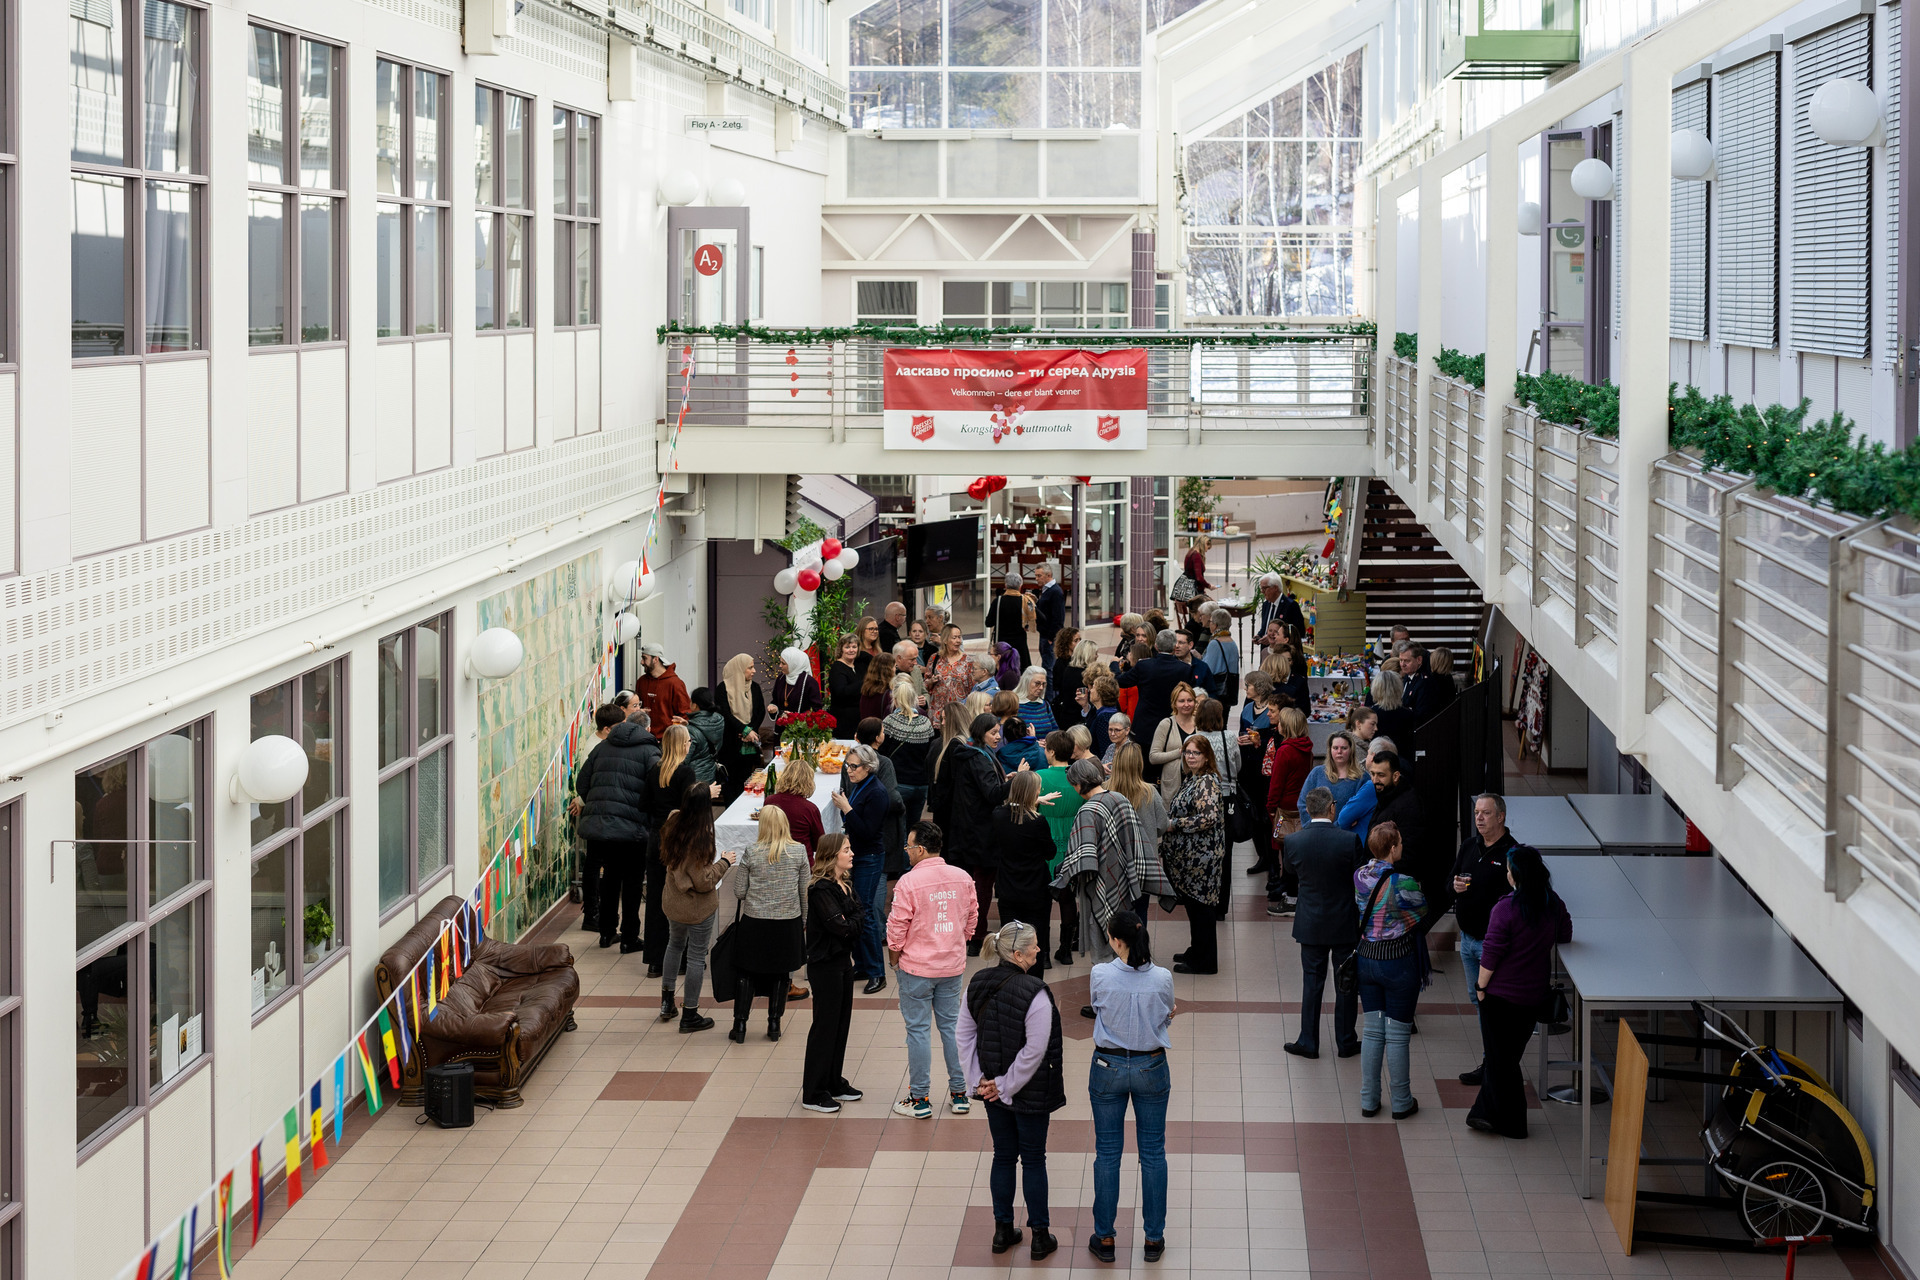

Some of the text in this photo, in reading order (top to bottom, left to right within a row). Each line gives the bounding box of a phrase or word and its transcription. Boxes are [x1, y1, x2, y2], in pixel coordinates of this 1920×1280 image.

[691, 121, 708, 129] Fløy
[699, 249, 718, 271] A2
[953, 368, 1014, 380] просимо
[1028, 369, 1045, 378] ти
[1048, 367, 1089, 379] серед
[1092, 365, 1137, 379] друзів
[950, 388, 995, 397] Velkommen
[1004, 388, 1022, 397] dere
[1034, 388, 1053, 396] blant
[1055, 388, 1081, 396] venner
[929, 891, 956, 902] CHOOSE
[938, 901, 947, 910] TO
[938, 912, 947, 921] BE
[934, 922, 953, 933] KIND
